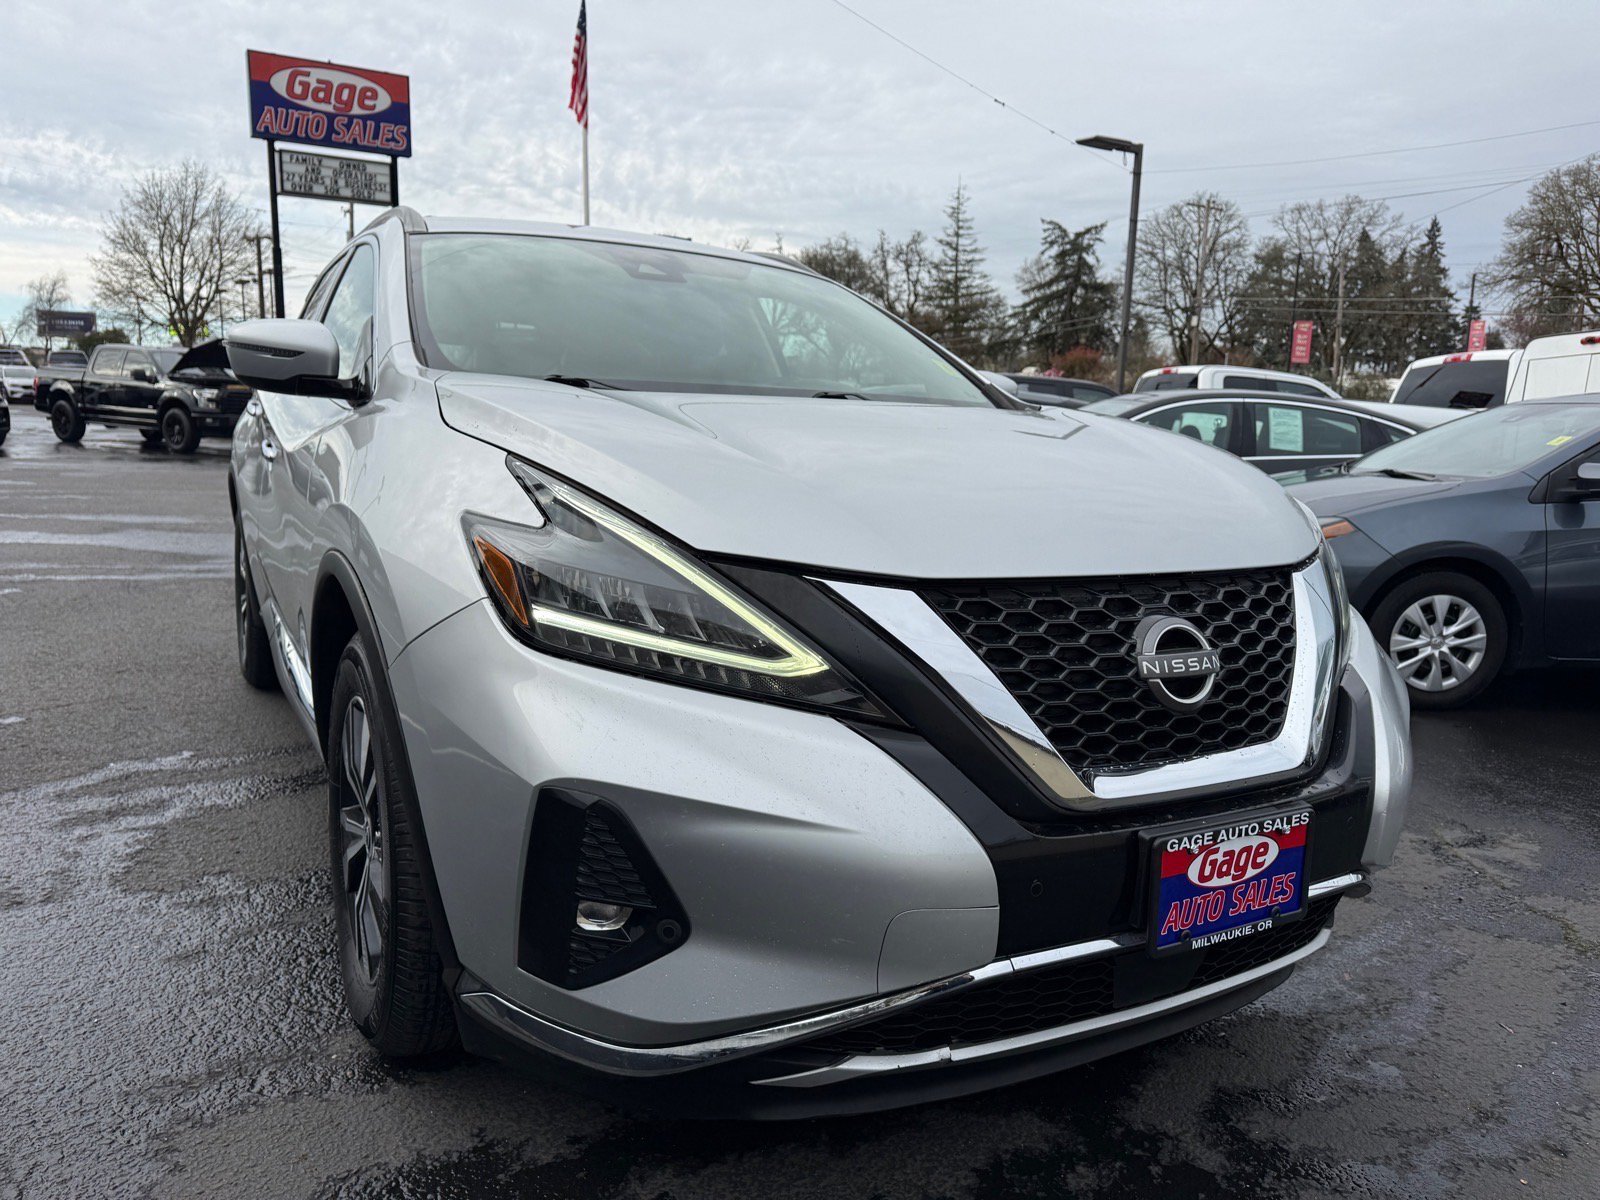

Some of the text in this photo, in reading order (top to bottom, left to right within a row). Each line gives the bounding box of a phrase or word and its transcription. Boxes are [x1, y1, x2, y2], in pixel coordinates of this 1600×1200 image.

[285, 68, 378, 113] Gage
[256, 105, 408, 151] AUTO SALES
[289, 154, 367, 172] FAMILY OWNED
[305, 164, 321, 175] AND
[291, 182, 313, 193] OVER
[299, 173, 325, 185] YEARS
[330, 176, 338, 185] IN
[1142, 655, 1220, 674] NISSAN
[1166, 812, 1310, 853] GAGE AUTO SALES
[1197, 841, 1270, 884] Gage
[1161, 872, 1296, 935] AUTO SALES
[1192, 919, 1273, 950] MILWAUKIE, OR
